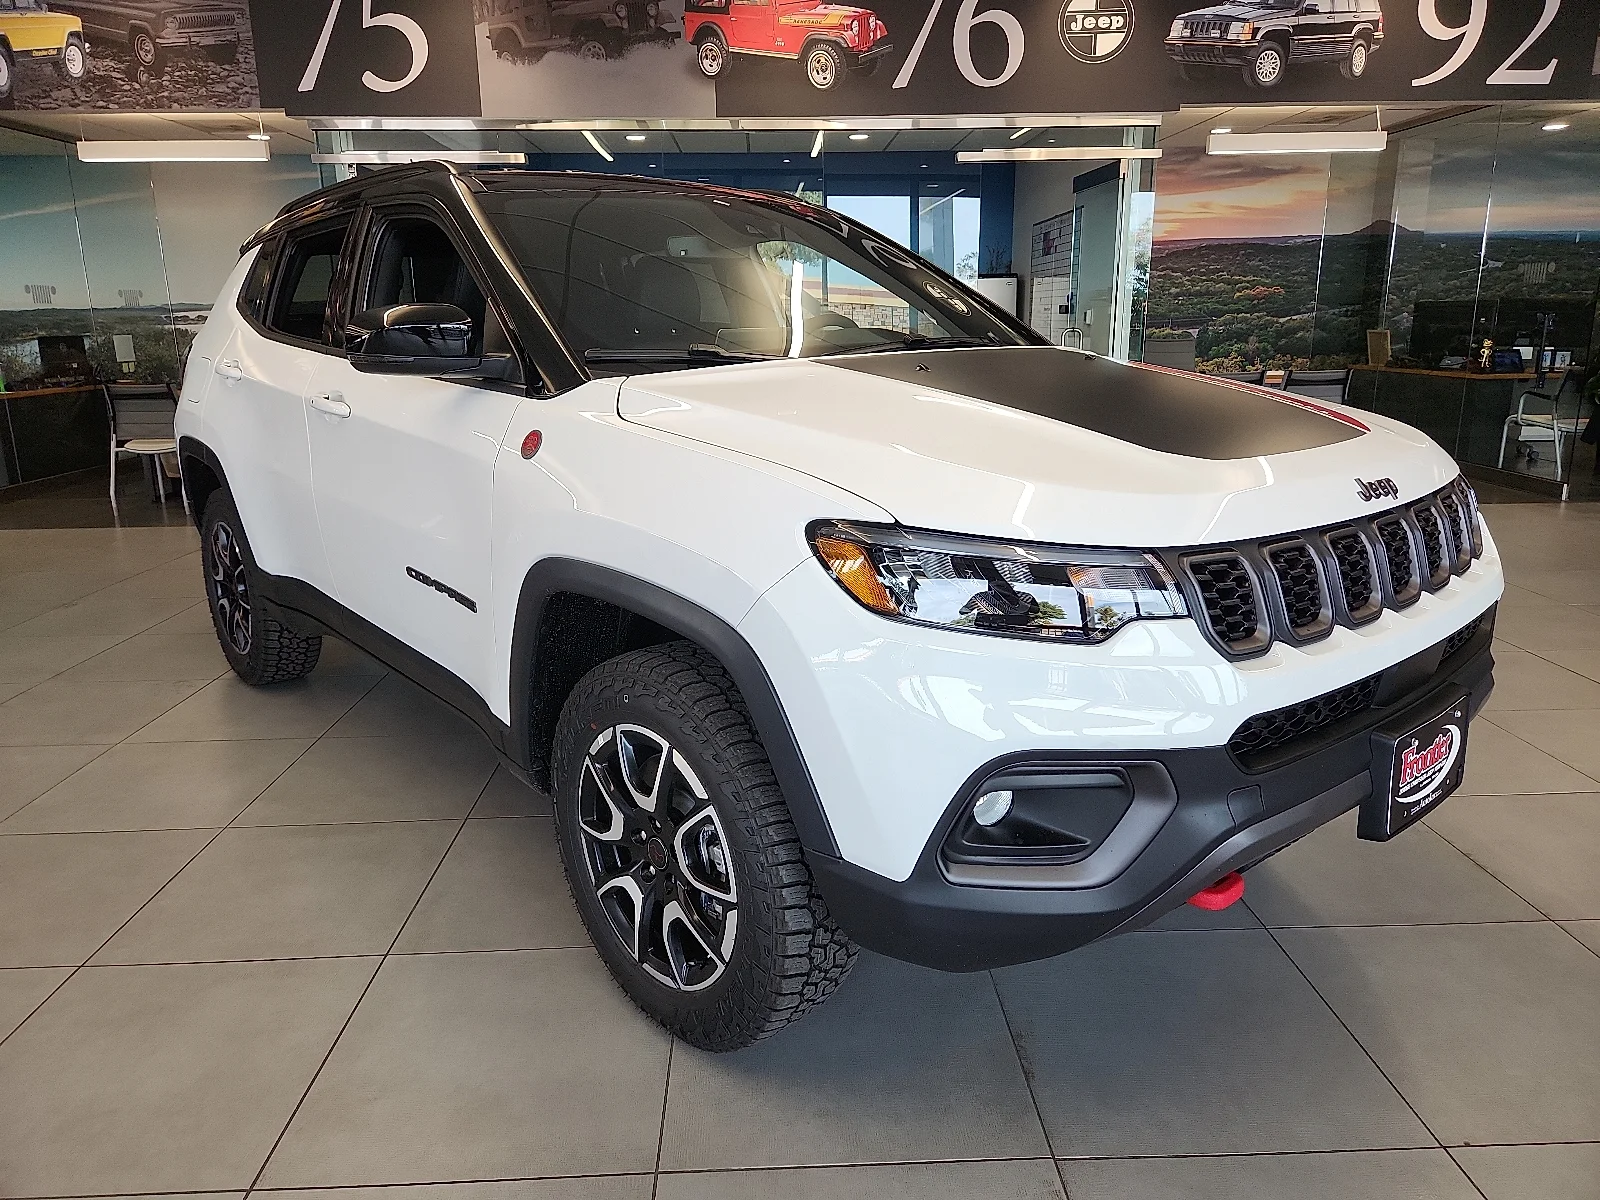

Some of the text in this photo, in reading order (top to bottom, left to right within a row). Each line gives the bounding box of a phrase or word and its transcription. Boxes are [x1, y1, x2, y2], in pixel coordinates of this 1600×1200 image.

[1070, 14, 1125, 31] Jeep
[1411, 0, 1561, 87] 92
[1353, 477, 1399, 502] Jeep
[1399, 732, 1451, 788] Frontier
